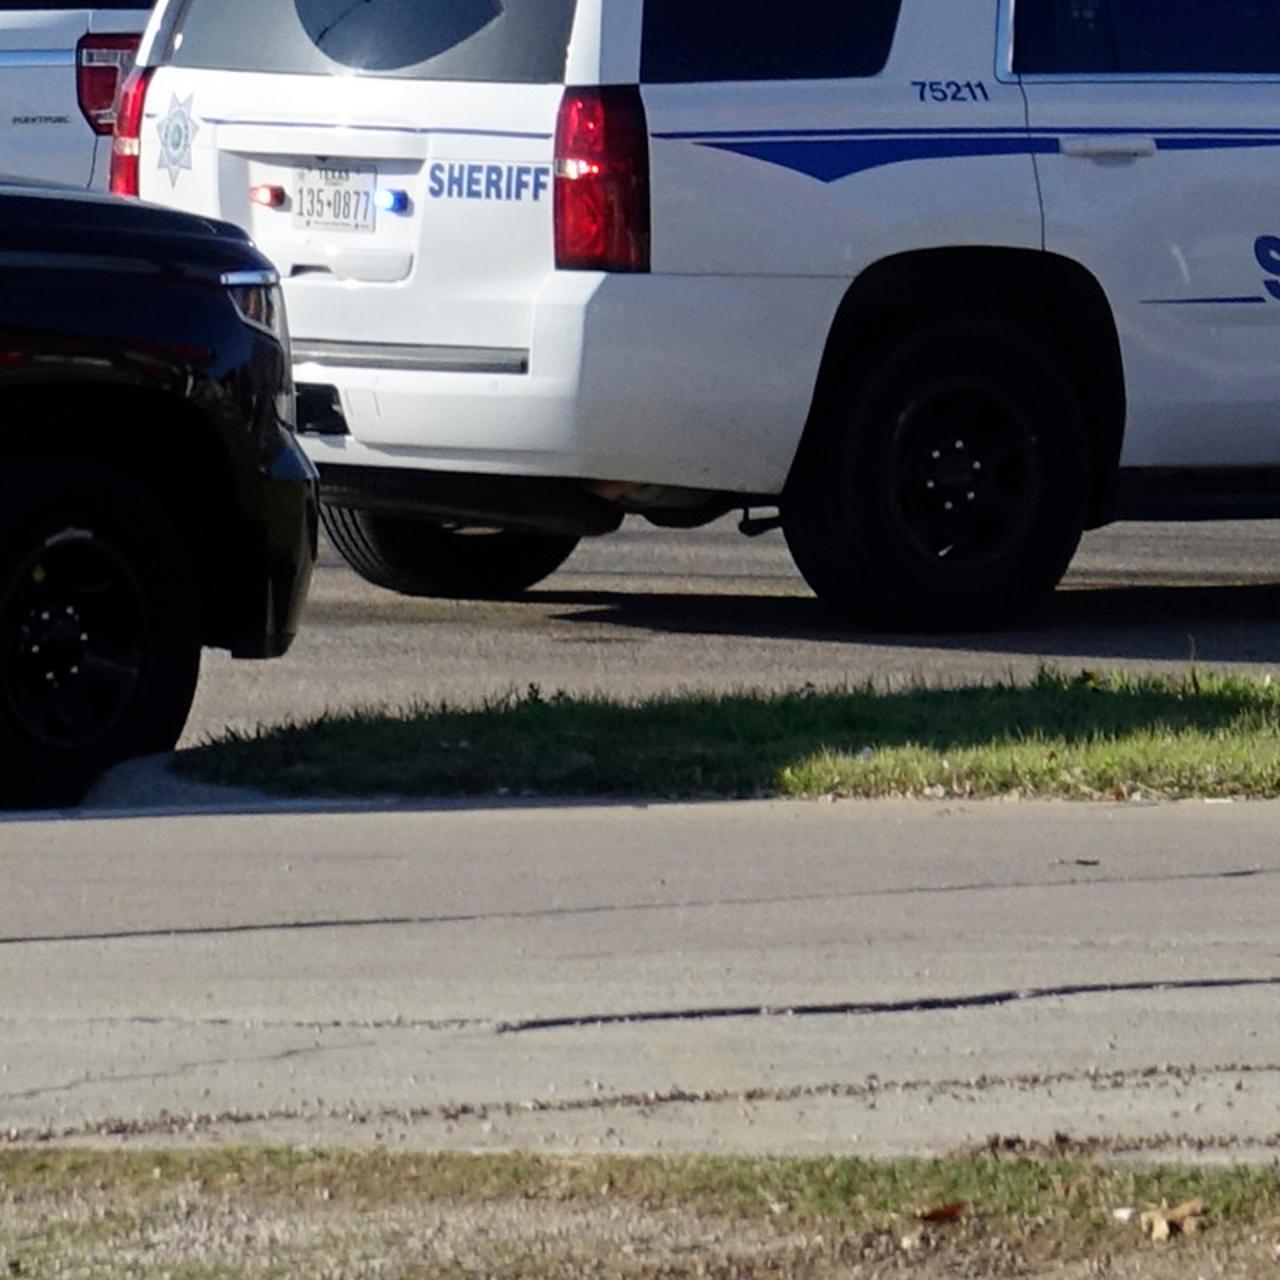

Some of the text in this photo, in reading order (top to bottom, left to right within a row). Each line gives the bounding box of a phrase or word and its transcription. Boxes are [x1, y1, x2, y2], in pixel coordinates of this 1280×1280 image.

[910, 80, 990, 103] 75211
[318, 167, 350, 182] TEXAS
[428, 162, 550, 201] SHERIFF
